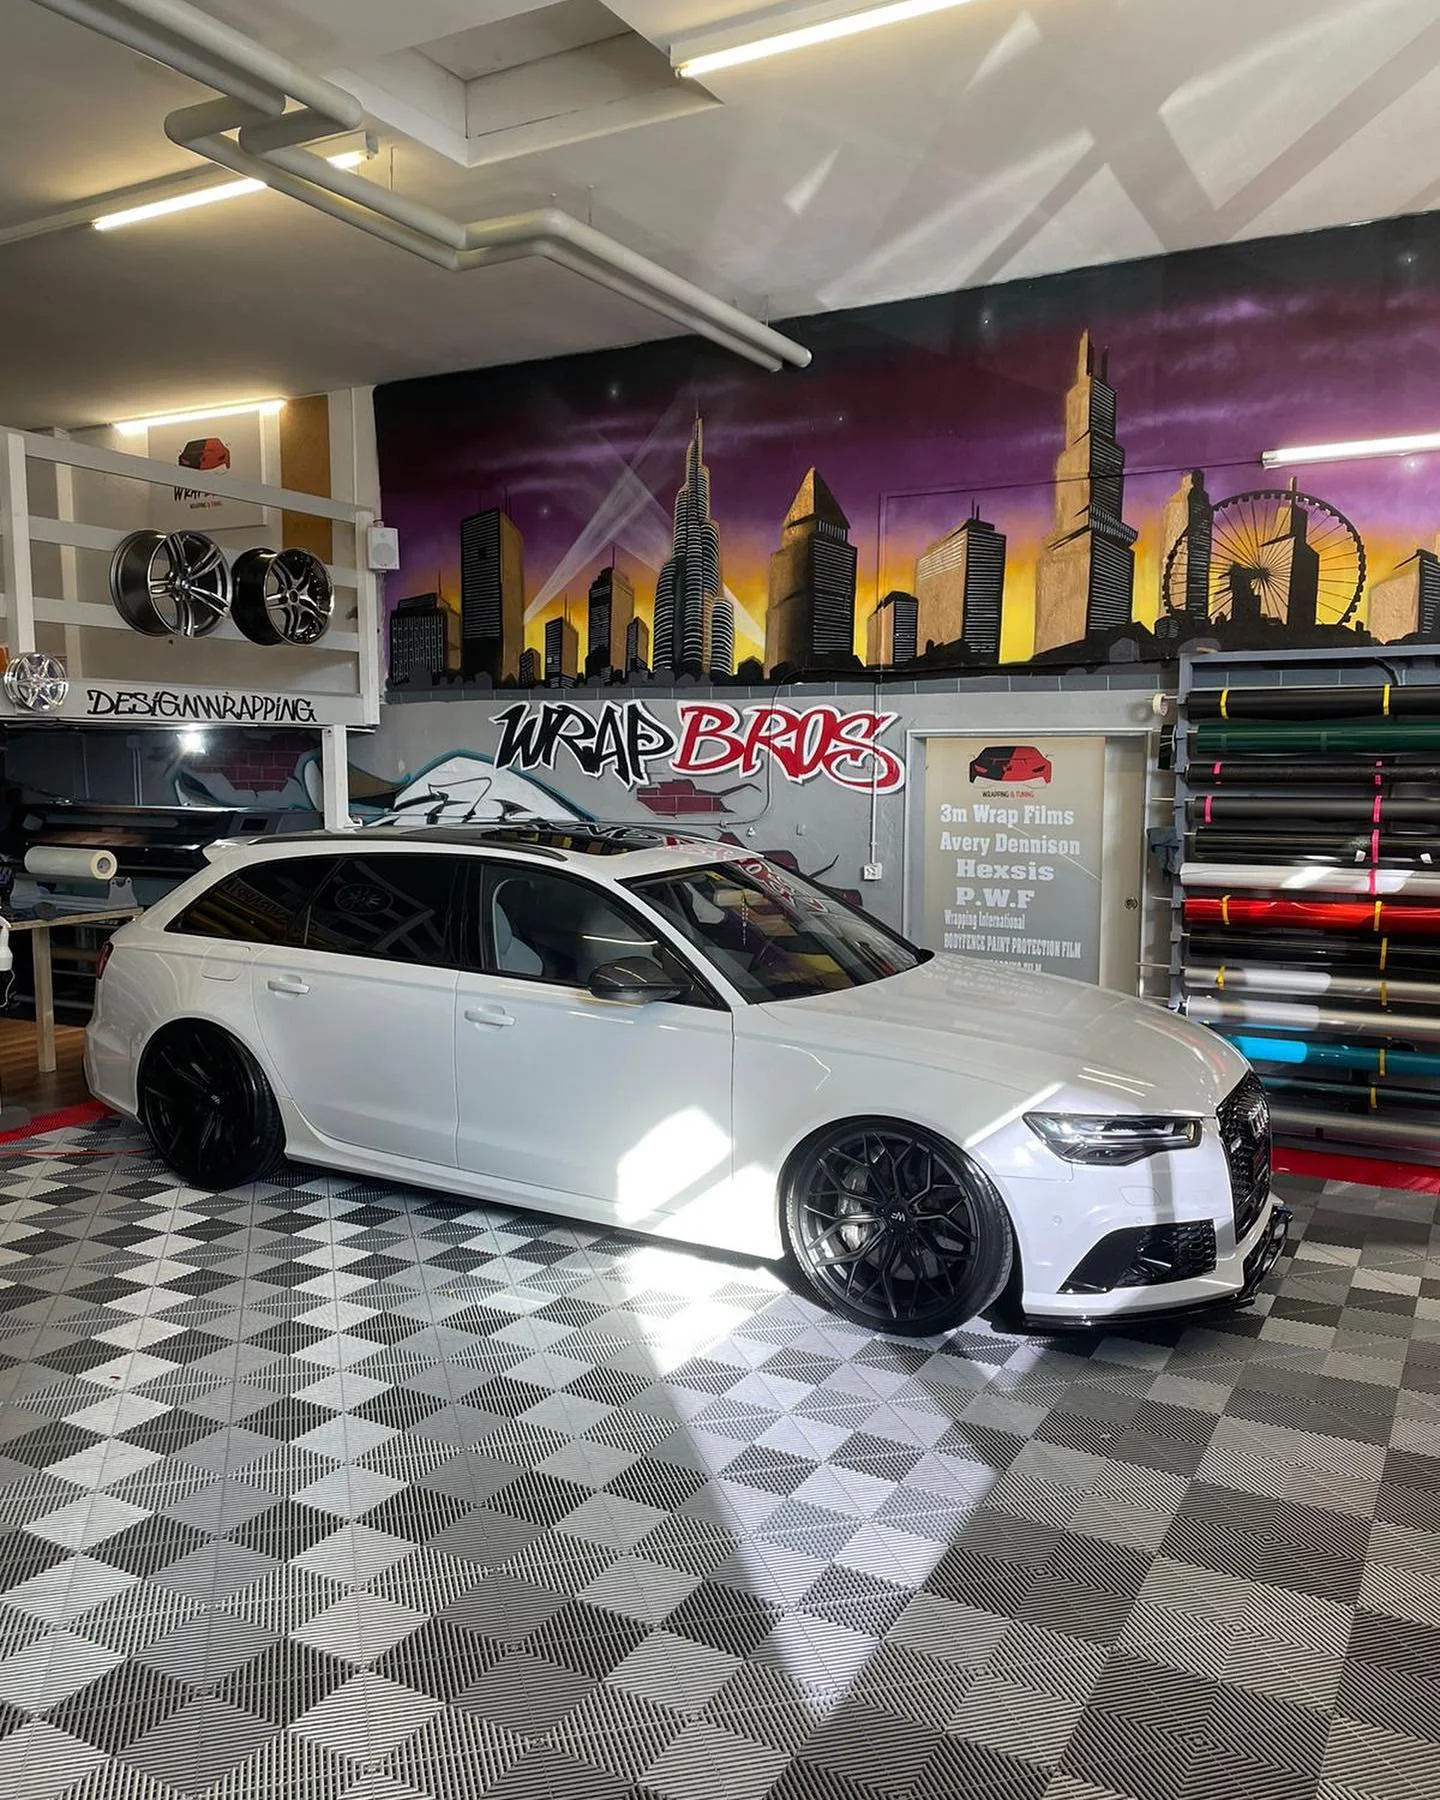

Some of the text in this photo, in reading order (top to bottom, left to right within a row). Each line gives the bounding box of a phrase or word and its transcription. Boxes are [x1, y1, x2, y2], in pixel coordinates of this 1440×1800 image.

[493, 700, 904, 794] WRAP BROS
[940, 804, 1074, 828] 3m Wrap Films
[940, 831, 1080, 856] Avery Dennison
[956, 858, 1054, 881] Hexsis
[956, 887, 1035, 908] P.W.F
[944, 910, 1025, 930] Wrapping International
[986, 935, 1010, 953] PAINT
[1011, 937, 1060, 957] PROTECTION
[1061, 940, 1081, 958] FILM
